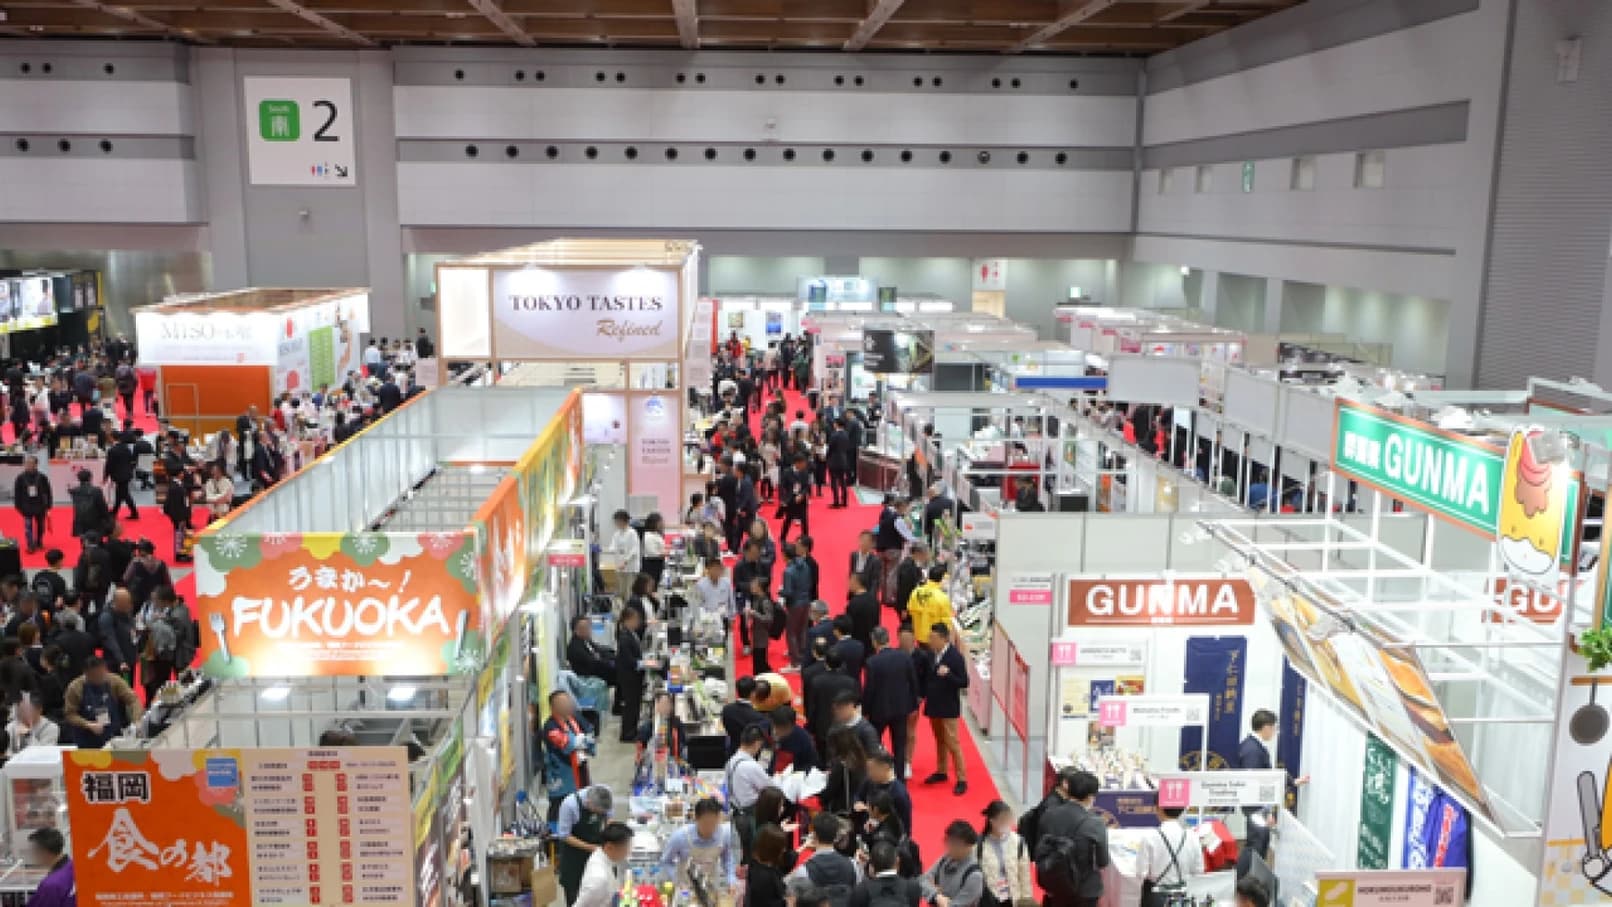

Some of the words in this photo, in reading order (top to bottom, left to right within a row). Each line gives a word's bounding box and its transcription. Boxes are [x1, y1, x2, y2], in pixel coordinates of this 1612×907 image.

[313, 100, 340, 142] 2
[508, 294, 583, 311] TOKYO
[586, 294, 664, 311] TASTES
[596, 318, 664, 343] Refined
[1384, 432, 1490, 516] GUNMA
[231, 594, 451, 638] FUKUOKA
[1085, 583, 1241, 616] GUNMA
[82, 771, 151, 804] 福岡
[87, 808, 233, 887] 食の都
